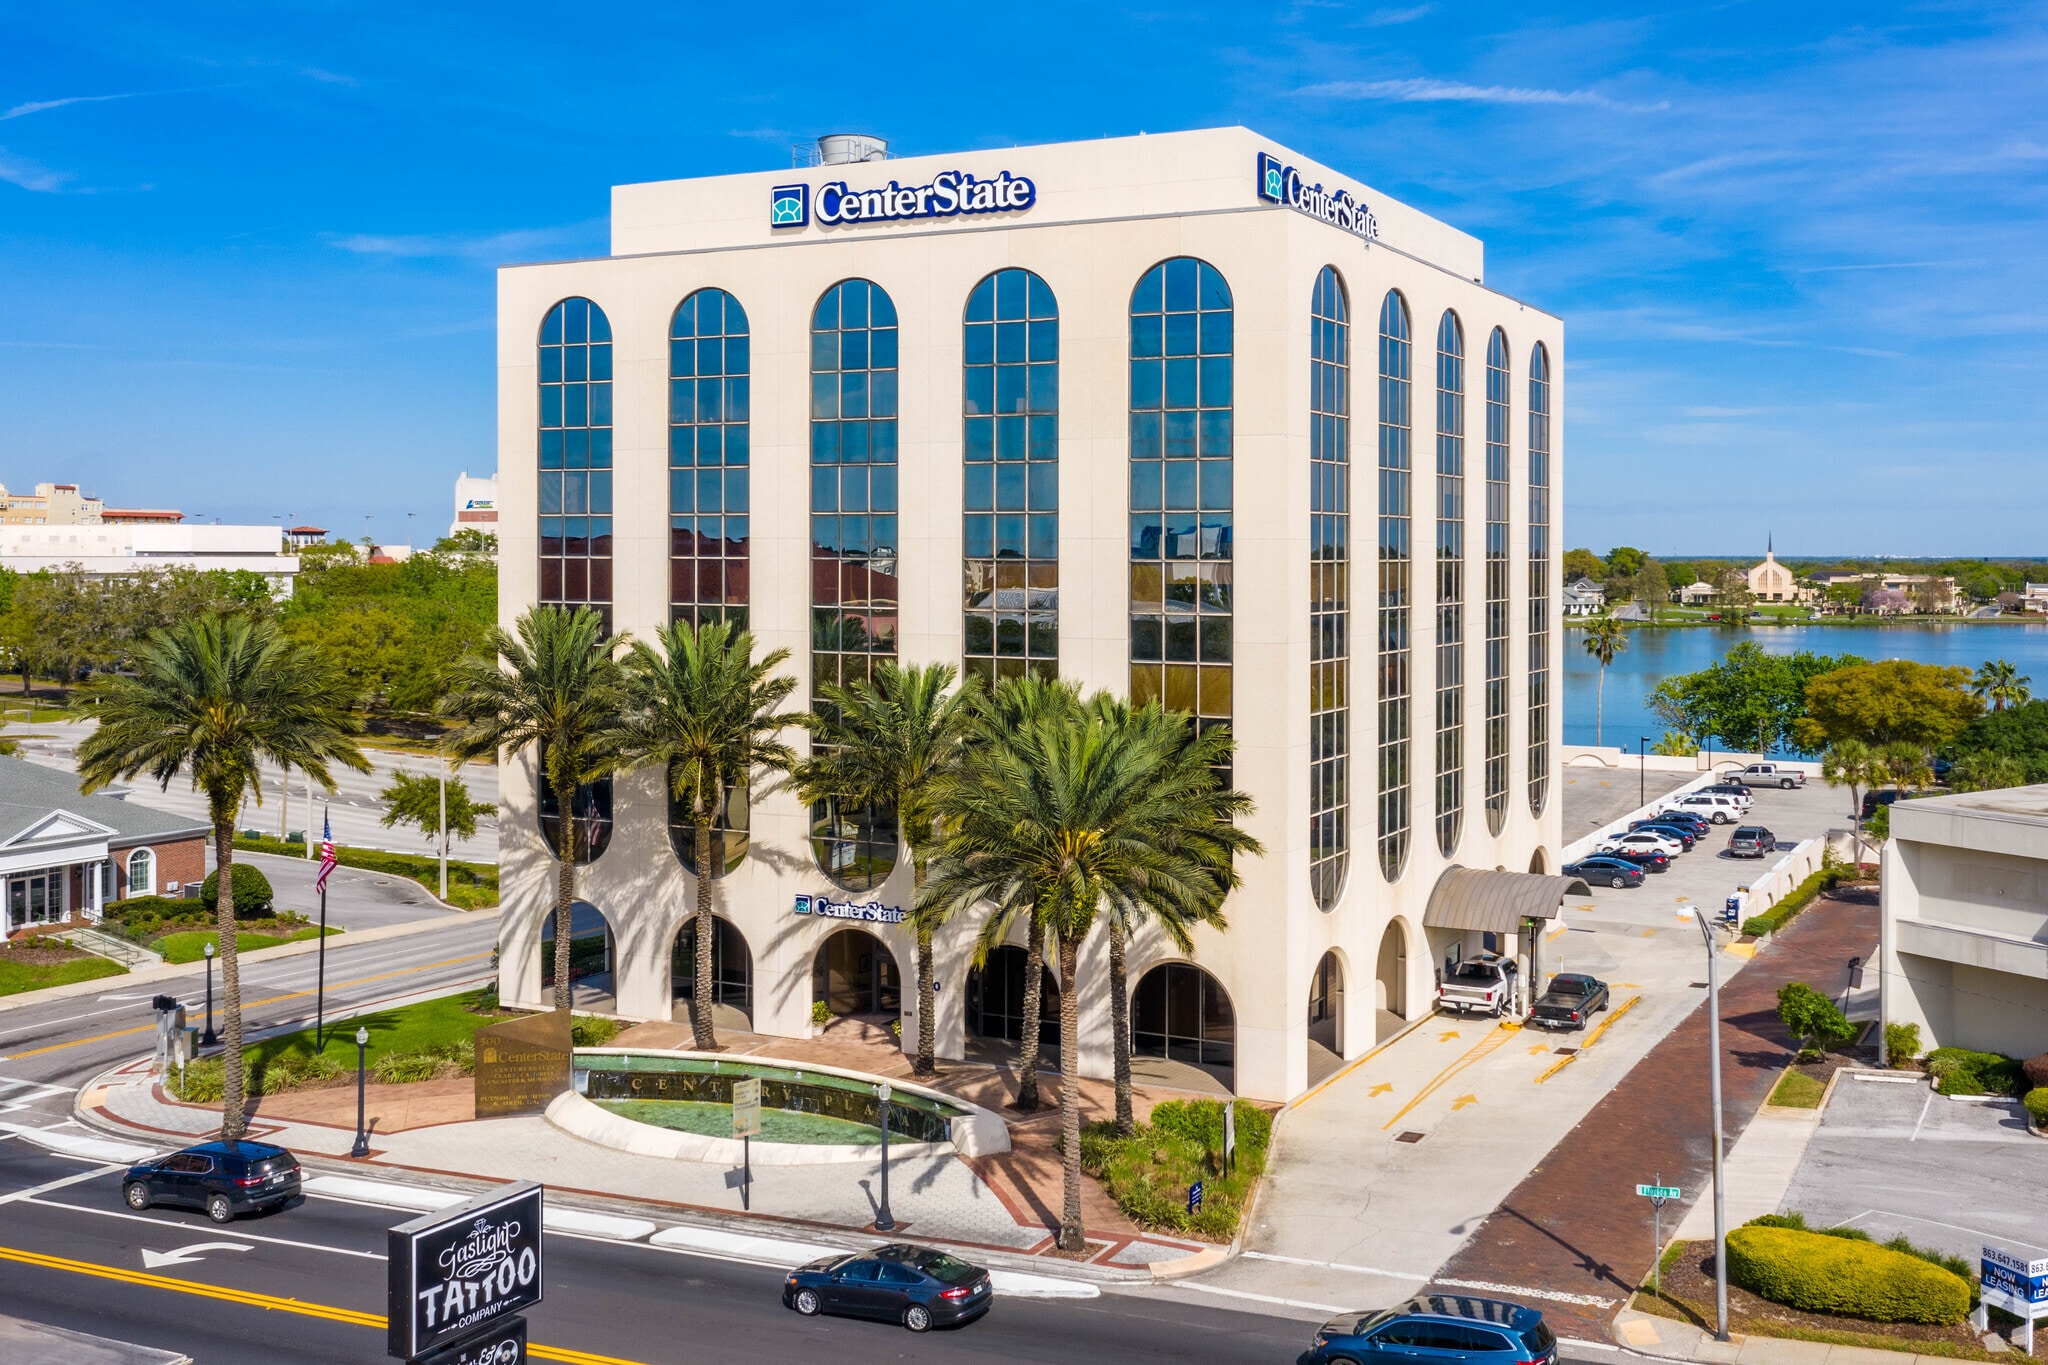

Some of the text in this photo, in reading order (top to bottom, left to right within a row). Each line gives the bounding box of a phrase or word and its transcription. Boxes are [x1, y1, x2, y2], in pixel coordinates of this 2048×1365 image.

[815, 172, 1031, 223] CenterState
[1287, 168, 1379, 240] CenterState
[814, 898, 906, 923] CenterState
[480, 1037, 501, 1046] 500
[498, 1050, 569, 1063] CenterState
[439, 1221, 521, 1281] Gaslight
[1982, 1247, 2029, 1274] 863.647.1581
[418, 1246, 536, 1328] TATTOO
[1985, 1273, 2025, 1298] LEASING
[1993, 1266, 2016, 1283] NOW
[458, 1301, 503, 1329] COMPANY
